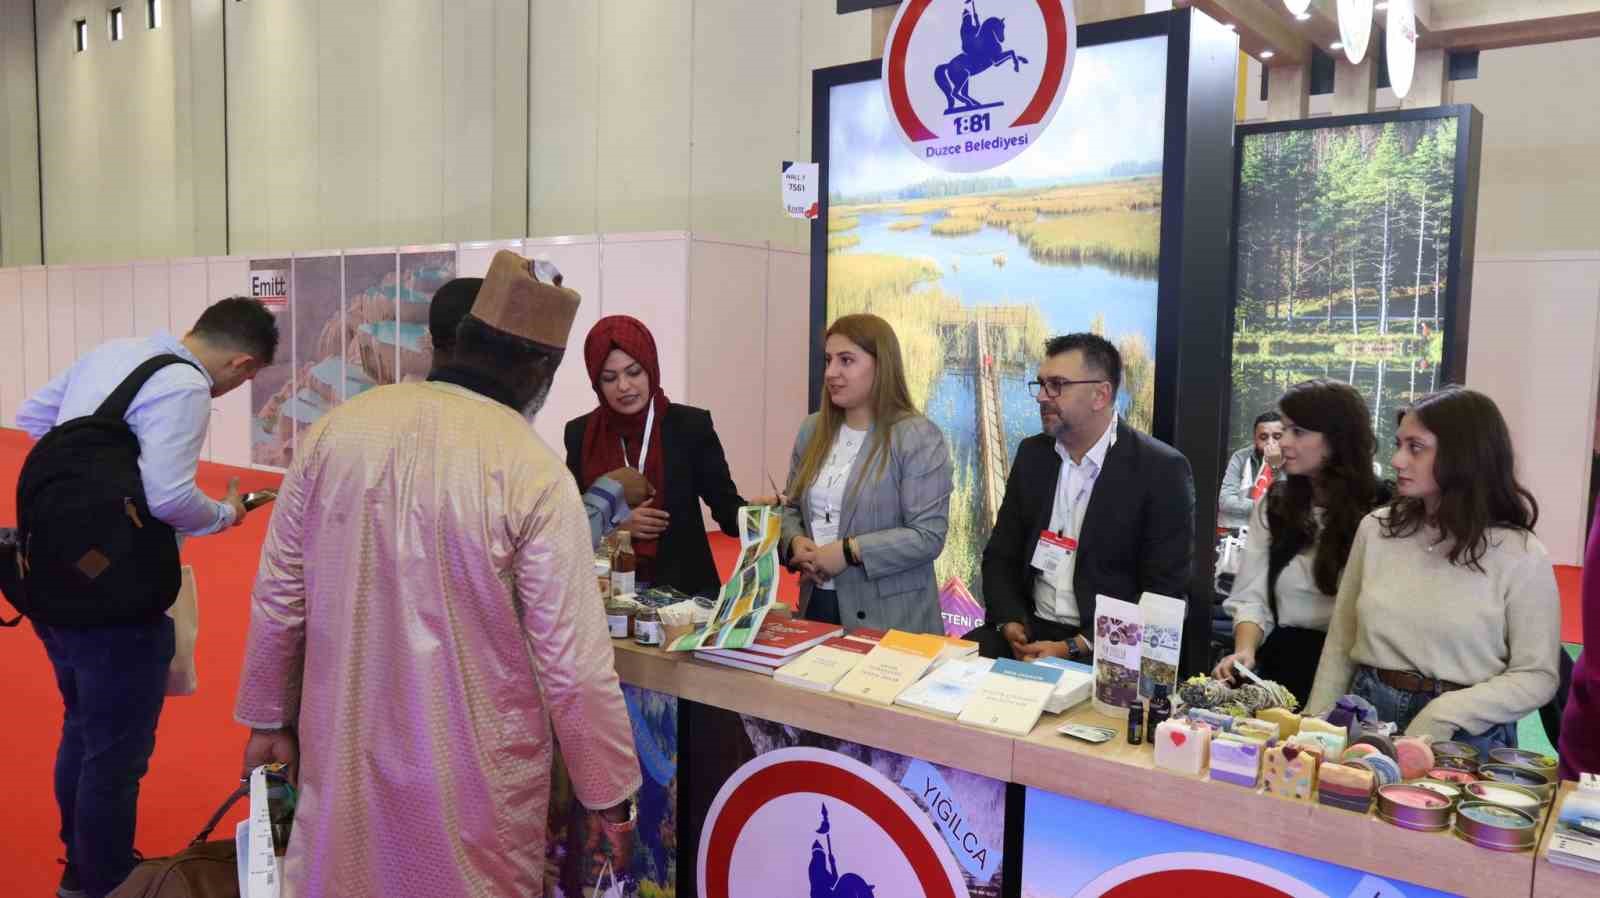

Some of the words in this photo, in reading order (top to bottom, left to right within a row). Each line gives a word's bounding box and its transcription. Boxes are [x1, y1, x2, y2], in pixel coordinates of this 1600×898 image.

[964, 133, 1029, 153] Belediyesi
[252, 276, 287, 297] Emitt
[923, 776, 988, 871] YIĞILCA
